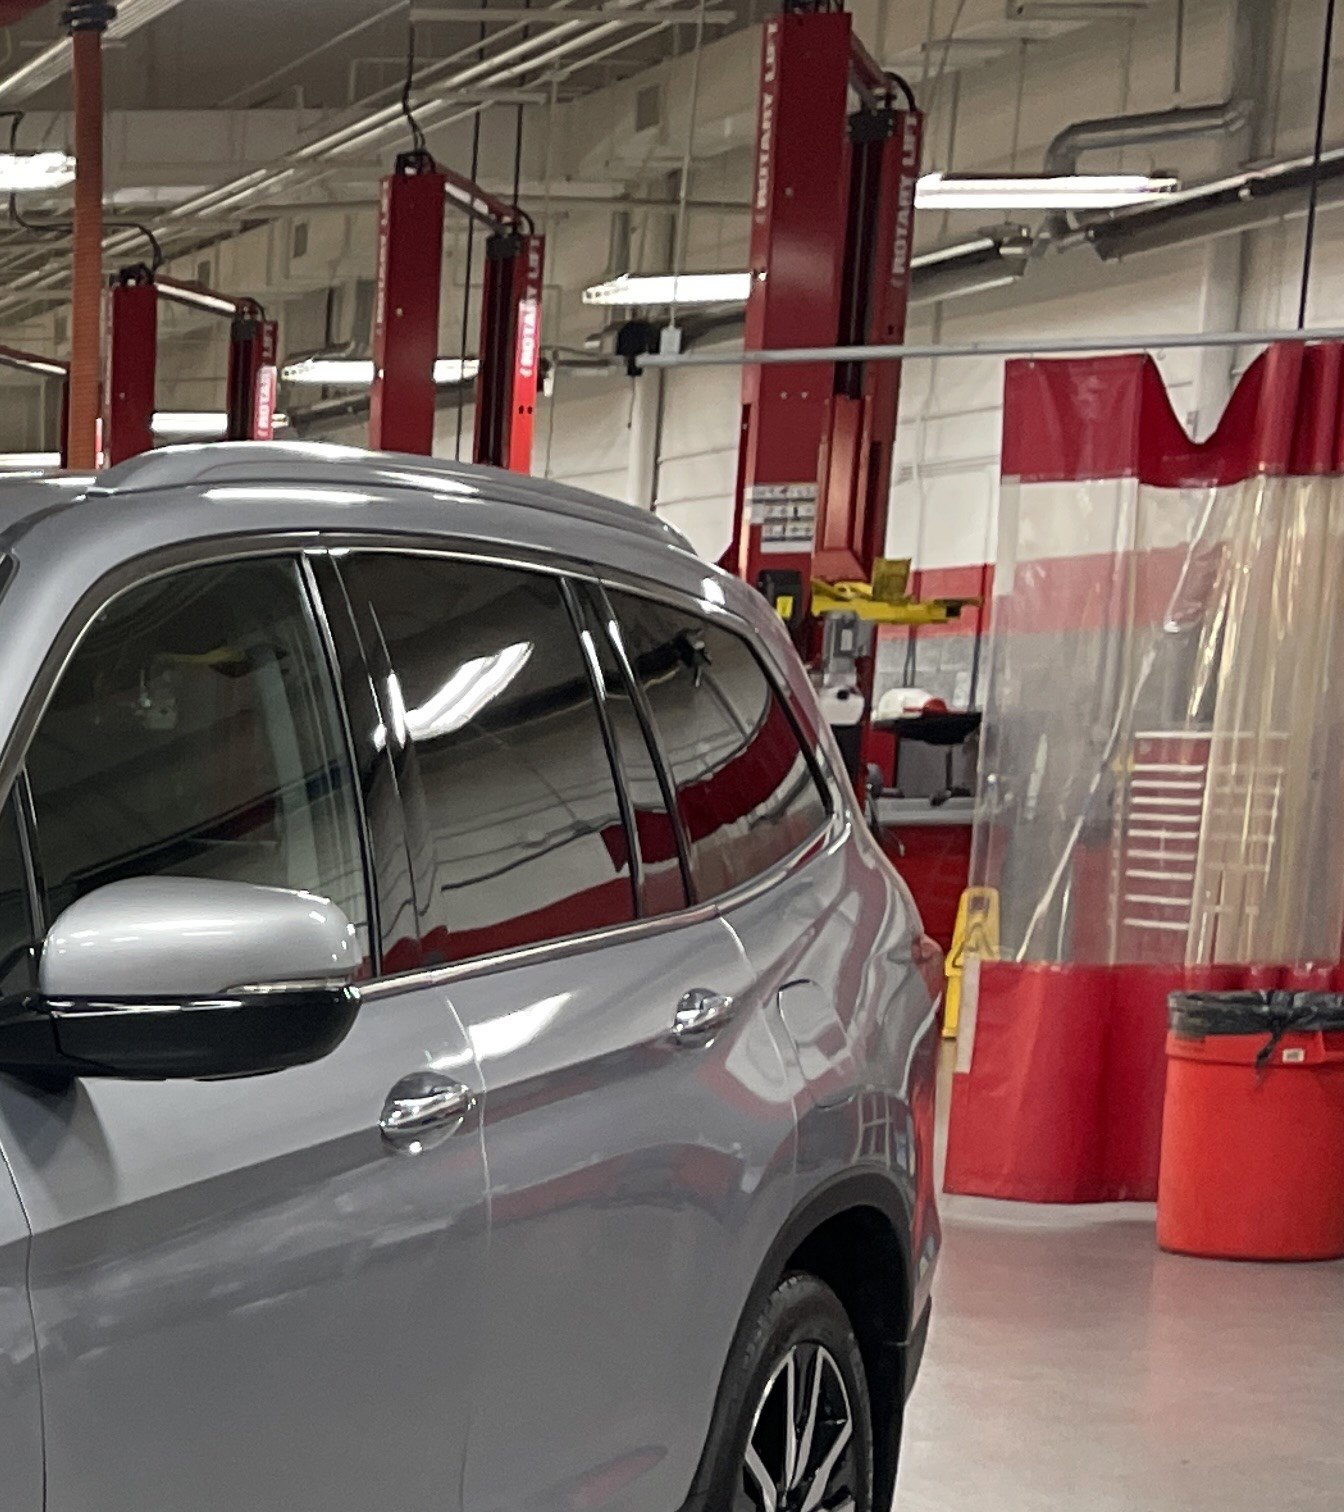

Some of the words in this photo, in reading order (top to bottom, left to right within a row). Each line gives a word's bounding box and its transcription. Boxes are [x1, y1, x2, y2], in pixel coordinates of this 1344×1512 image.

[765, 22, 778, 82] LIFT
[902, 115, 917, 167] LIFT
[893, 176, 913, 273] ROTARY
[528, 239, 540, 279] LIFT
[520, 287, 538, 368] ROTARY
